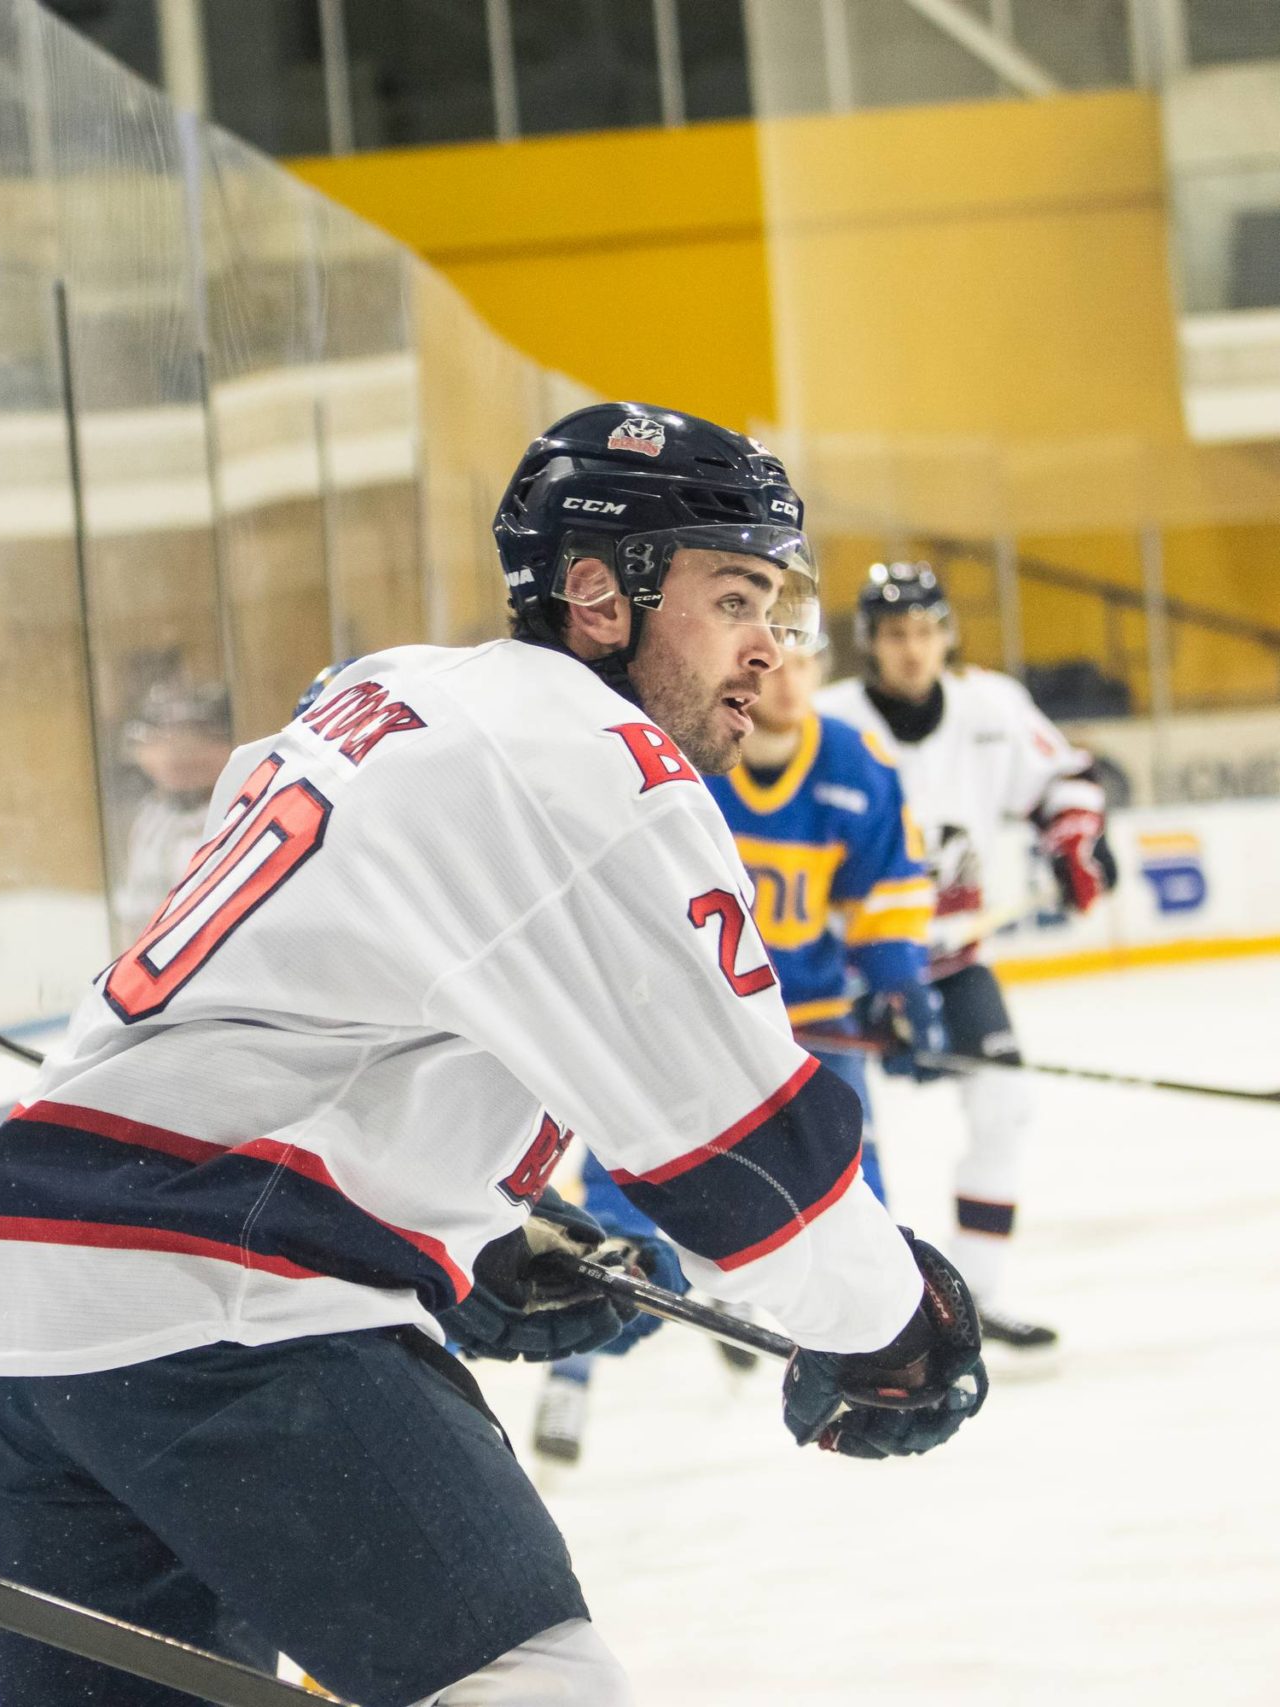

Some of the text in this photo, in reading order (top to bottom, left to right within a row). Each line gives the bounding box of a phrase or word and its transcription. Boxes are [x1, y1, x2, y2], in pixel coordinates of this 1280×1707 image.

[562, 496, 628, 516] CCM
[632, 594, 663, 602] CCM
[601, 722, 701, 795] B
[687, 876, 782, 998] 2
